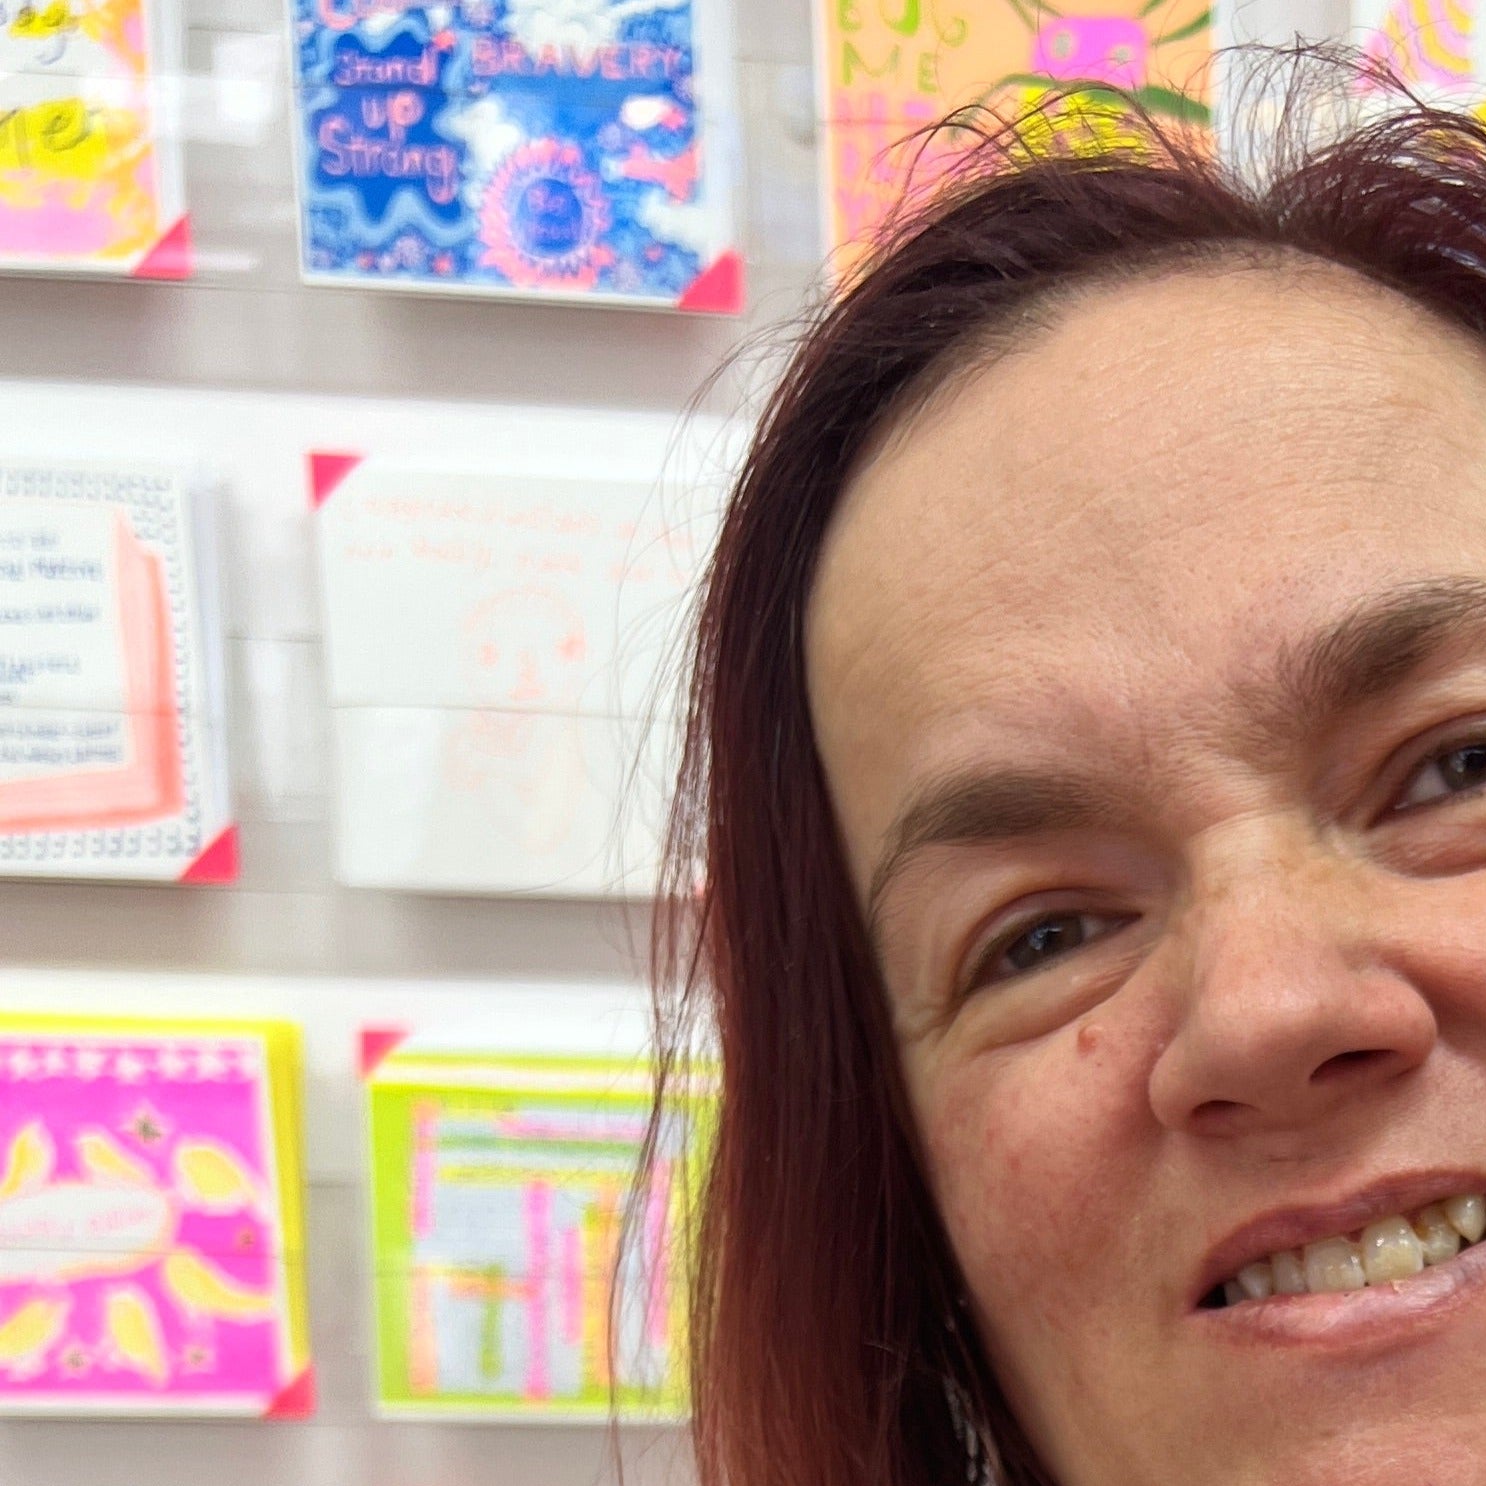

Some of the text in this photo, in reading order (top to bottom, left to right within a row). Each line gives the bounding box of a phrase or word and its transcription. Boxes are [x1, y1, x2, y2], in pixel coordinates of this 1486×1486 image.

[470, 34, 685, 80] BRAVERY
[361, 91, 424, 144] up
[317, 115, 460, 206] Strong
